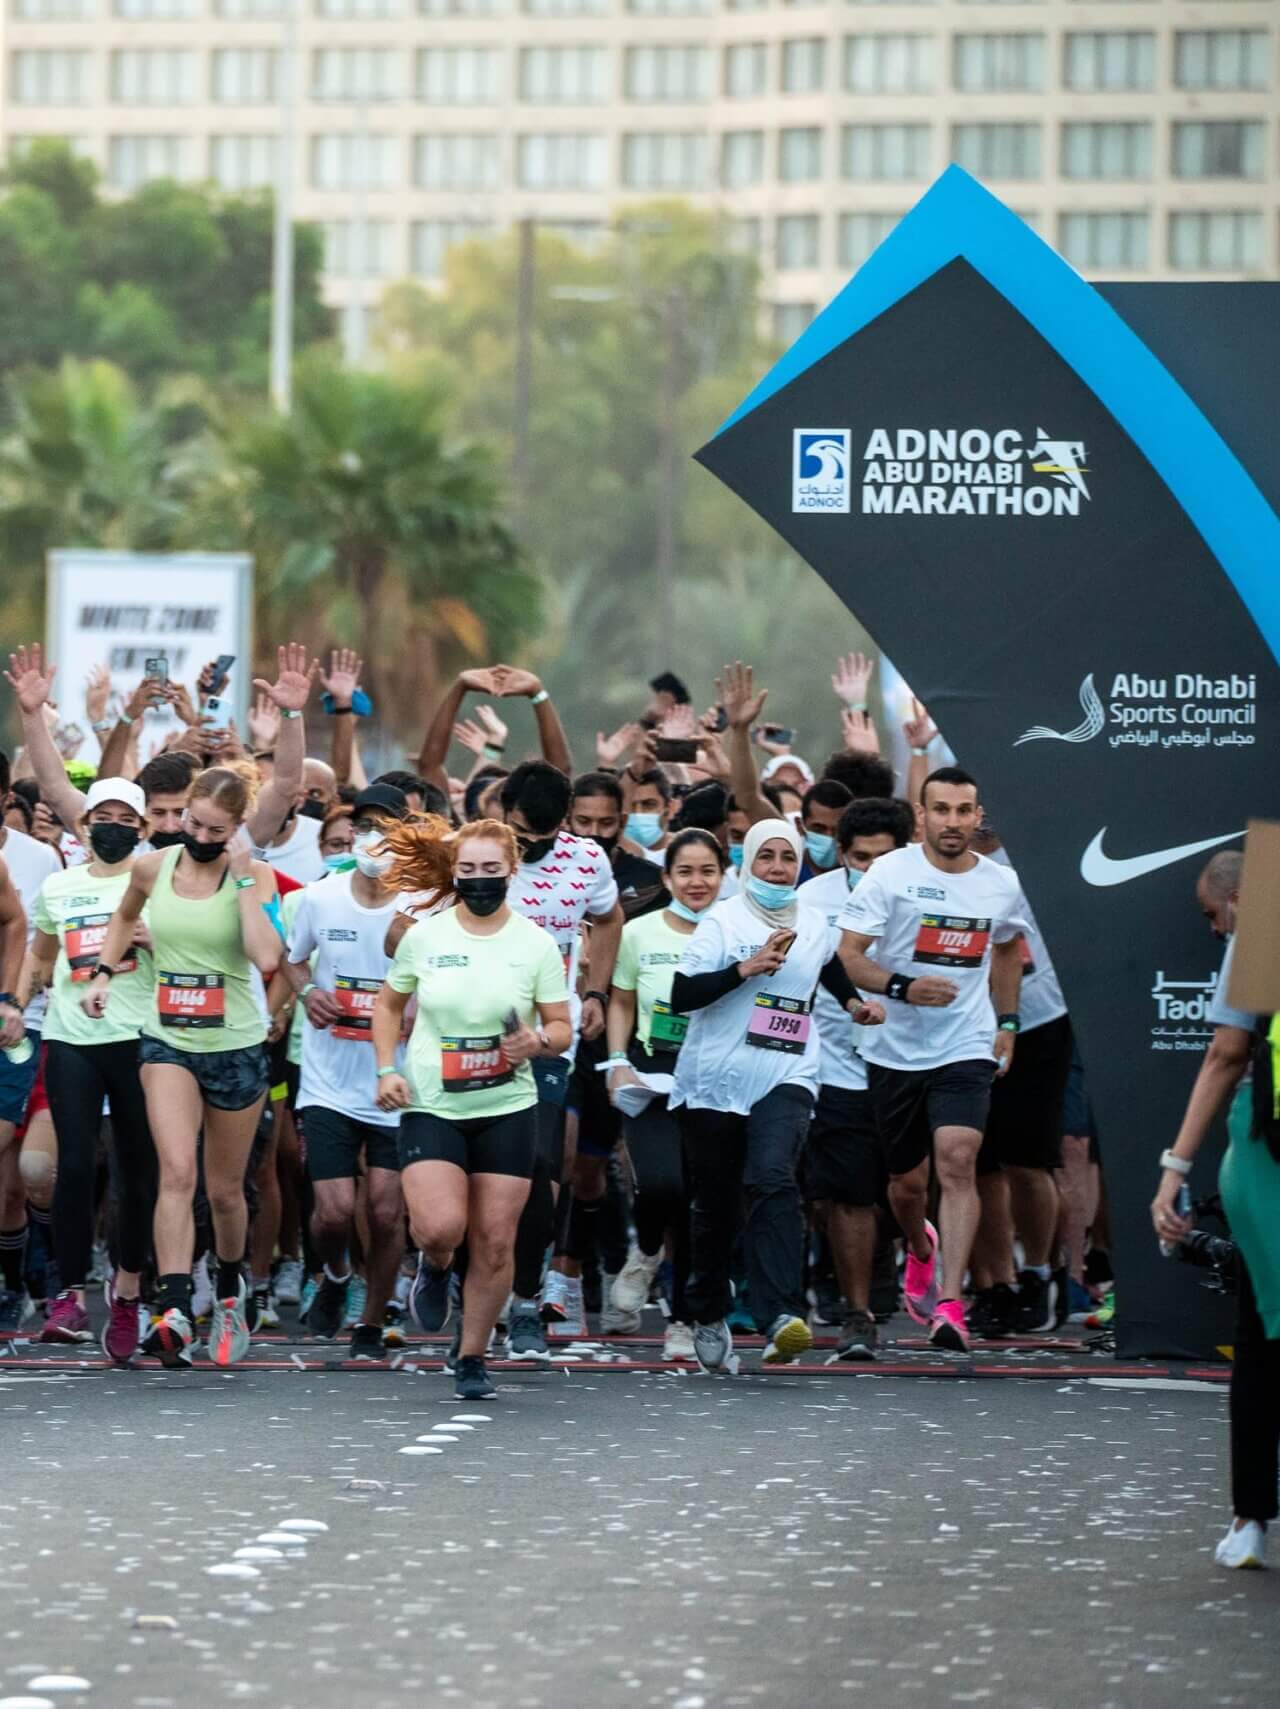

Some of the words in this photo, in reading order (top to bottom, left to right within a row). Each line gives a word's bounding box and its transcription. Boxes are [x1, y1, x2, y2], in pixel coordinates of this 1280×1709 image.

[863, 429, 1023, 461] ADNOC
[863, 462, 924, 484] ABU
[931, 463, 1022, 484] DHABI
[799, 497, 843, 508] ADNOC
[862, 485, 1080, 516] MARATHON
[1111, 673, 1167, 698] Abu
[1176, 674, 1256, 699] Dhabi
[1109, 703, 1177, 727] Sports
[1182, 704, 1256, 724] Council
[1109, 730, 1158, 747] الرياضي
[1213, 730, 1256, 747] مجلس
[1151, 993, 1207, 1020] Tad
